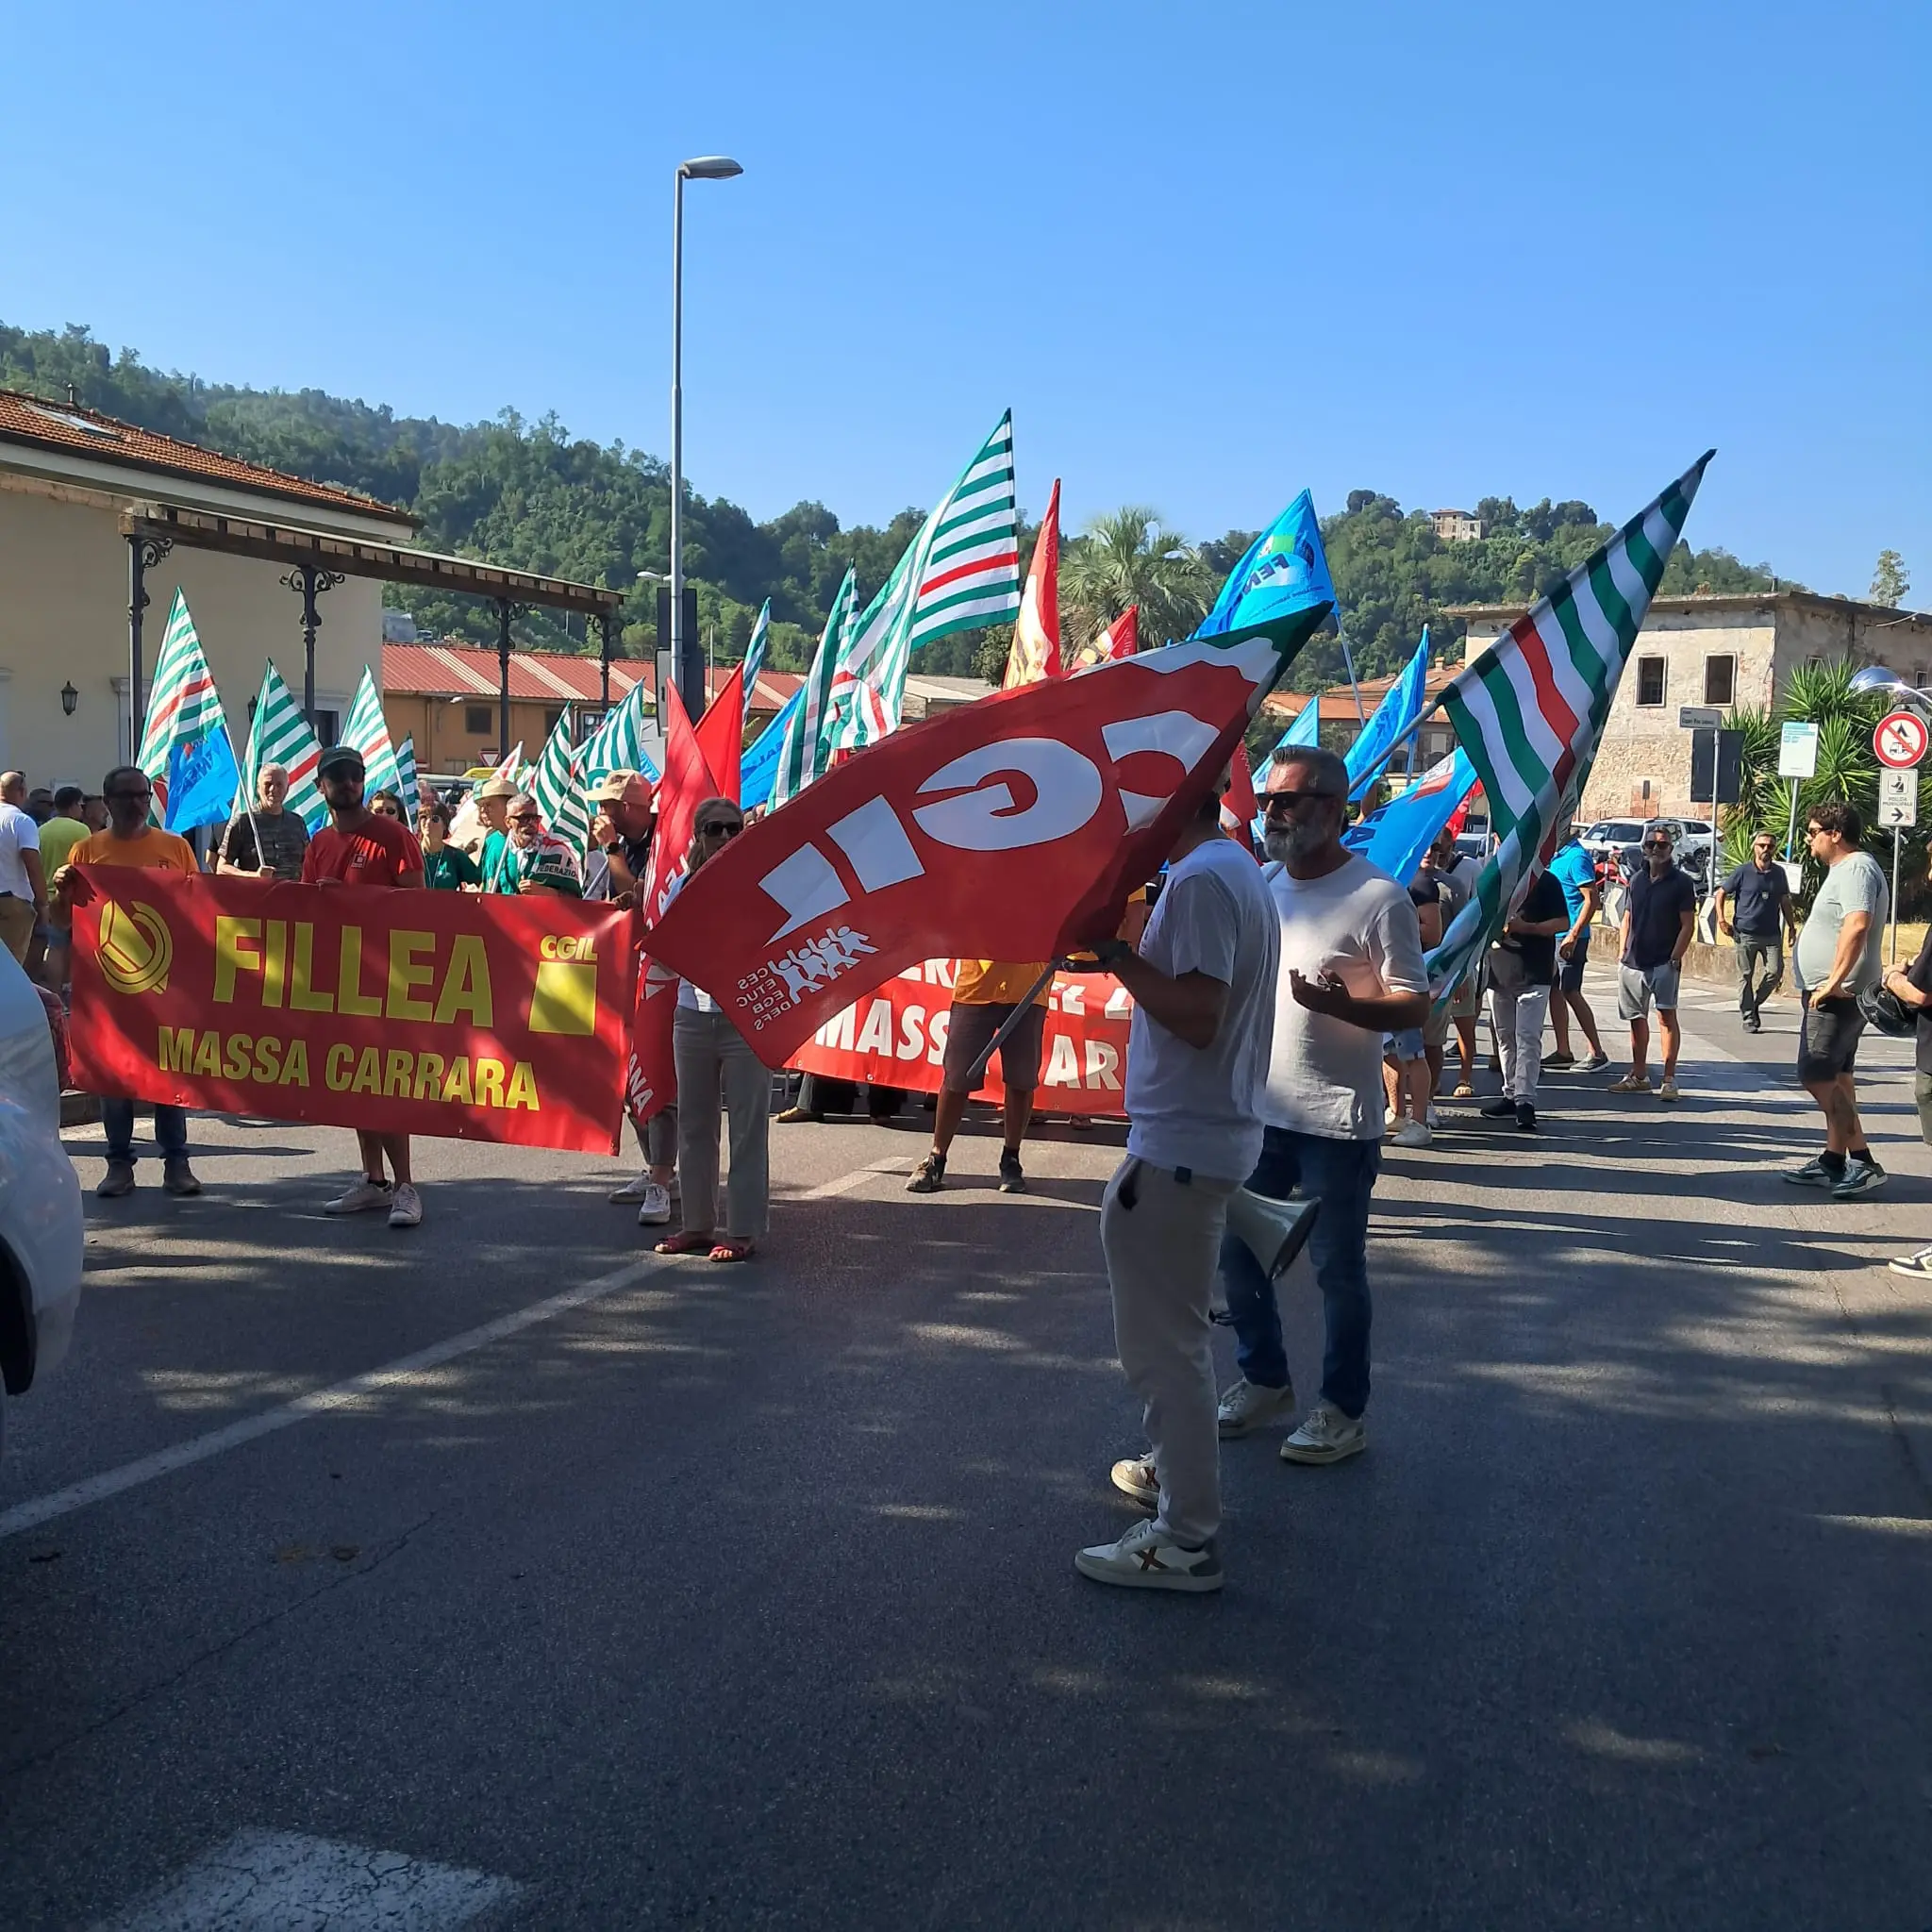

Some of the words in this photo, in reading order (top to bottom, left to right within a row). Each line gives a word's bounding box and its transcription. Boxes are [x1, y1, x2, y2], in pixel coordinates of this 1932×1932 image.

[213, 915, 493, 1028] FILLEA
[540, 935, 598, 962] CGIL
[158, 1025, 310, 1087] MASSA
[325, 1043, 541, 1111] CARRARA
[814, 998, 989, 1074] MASS
